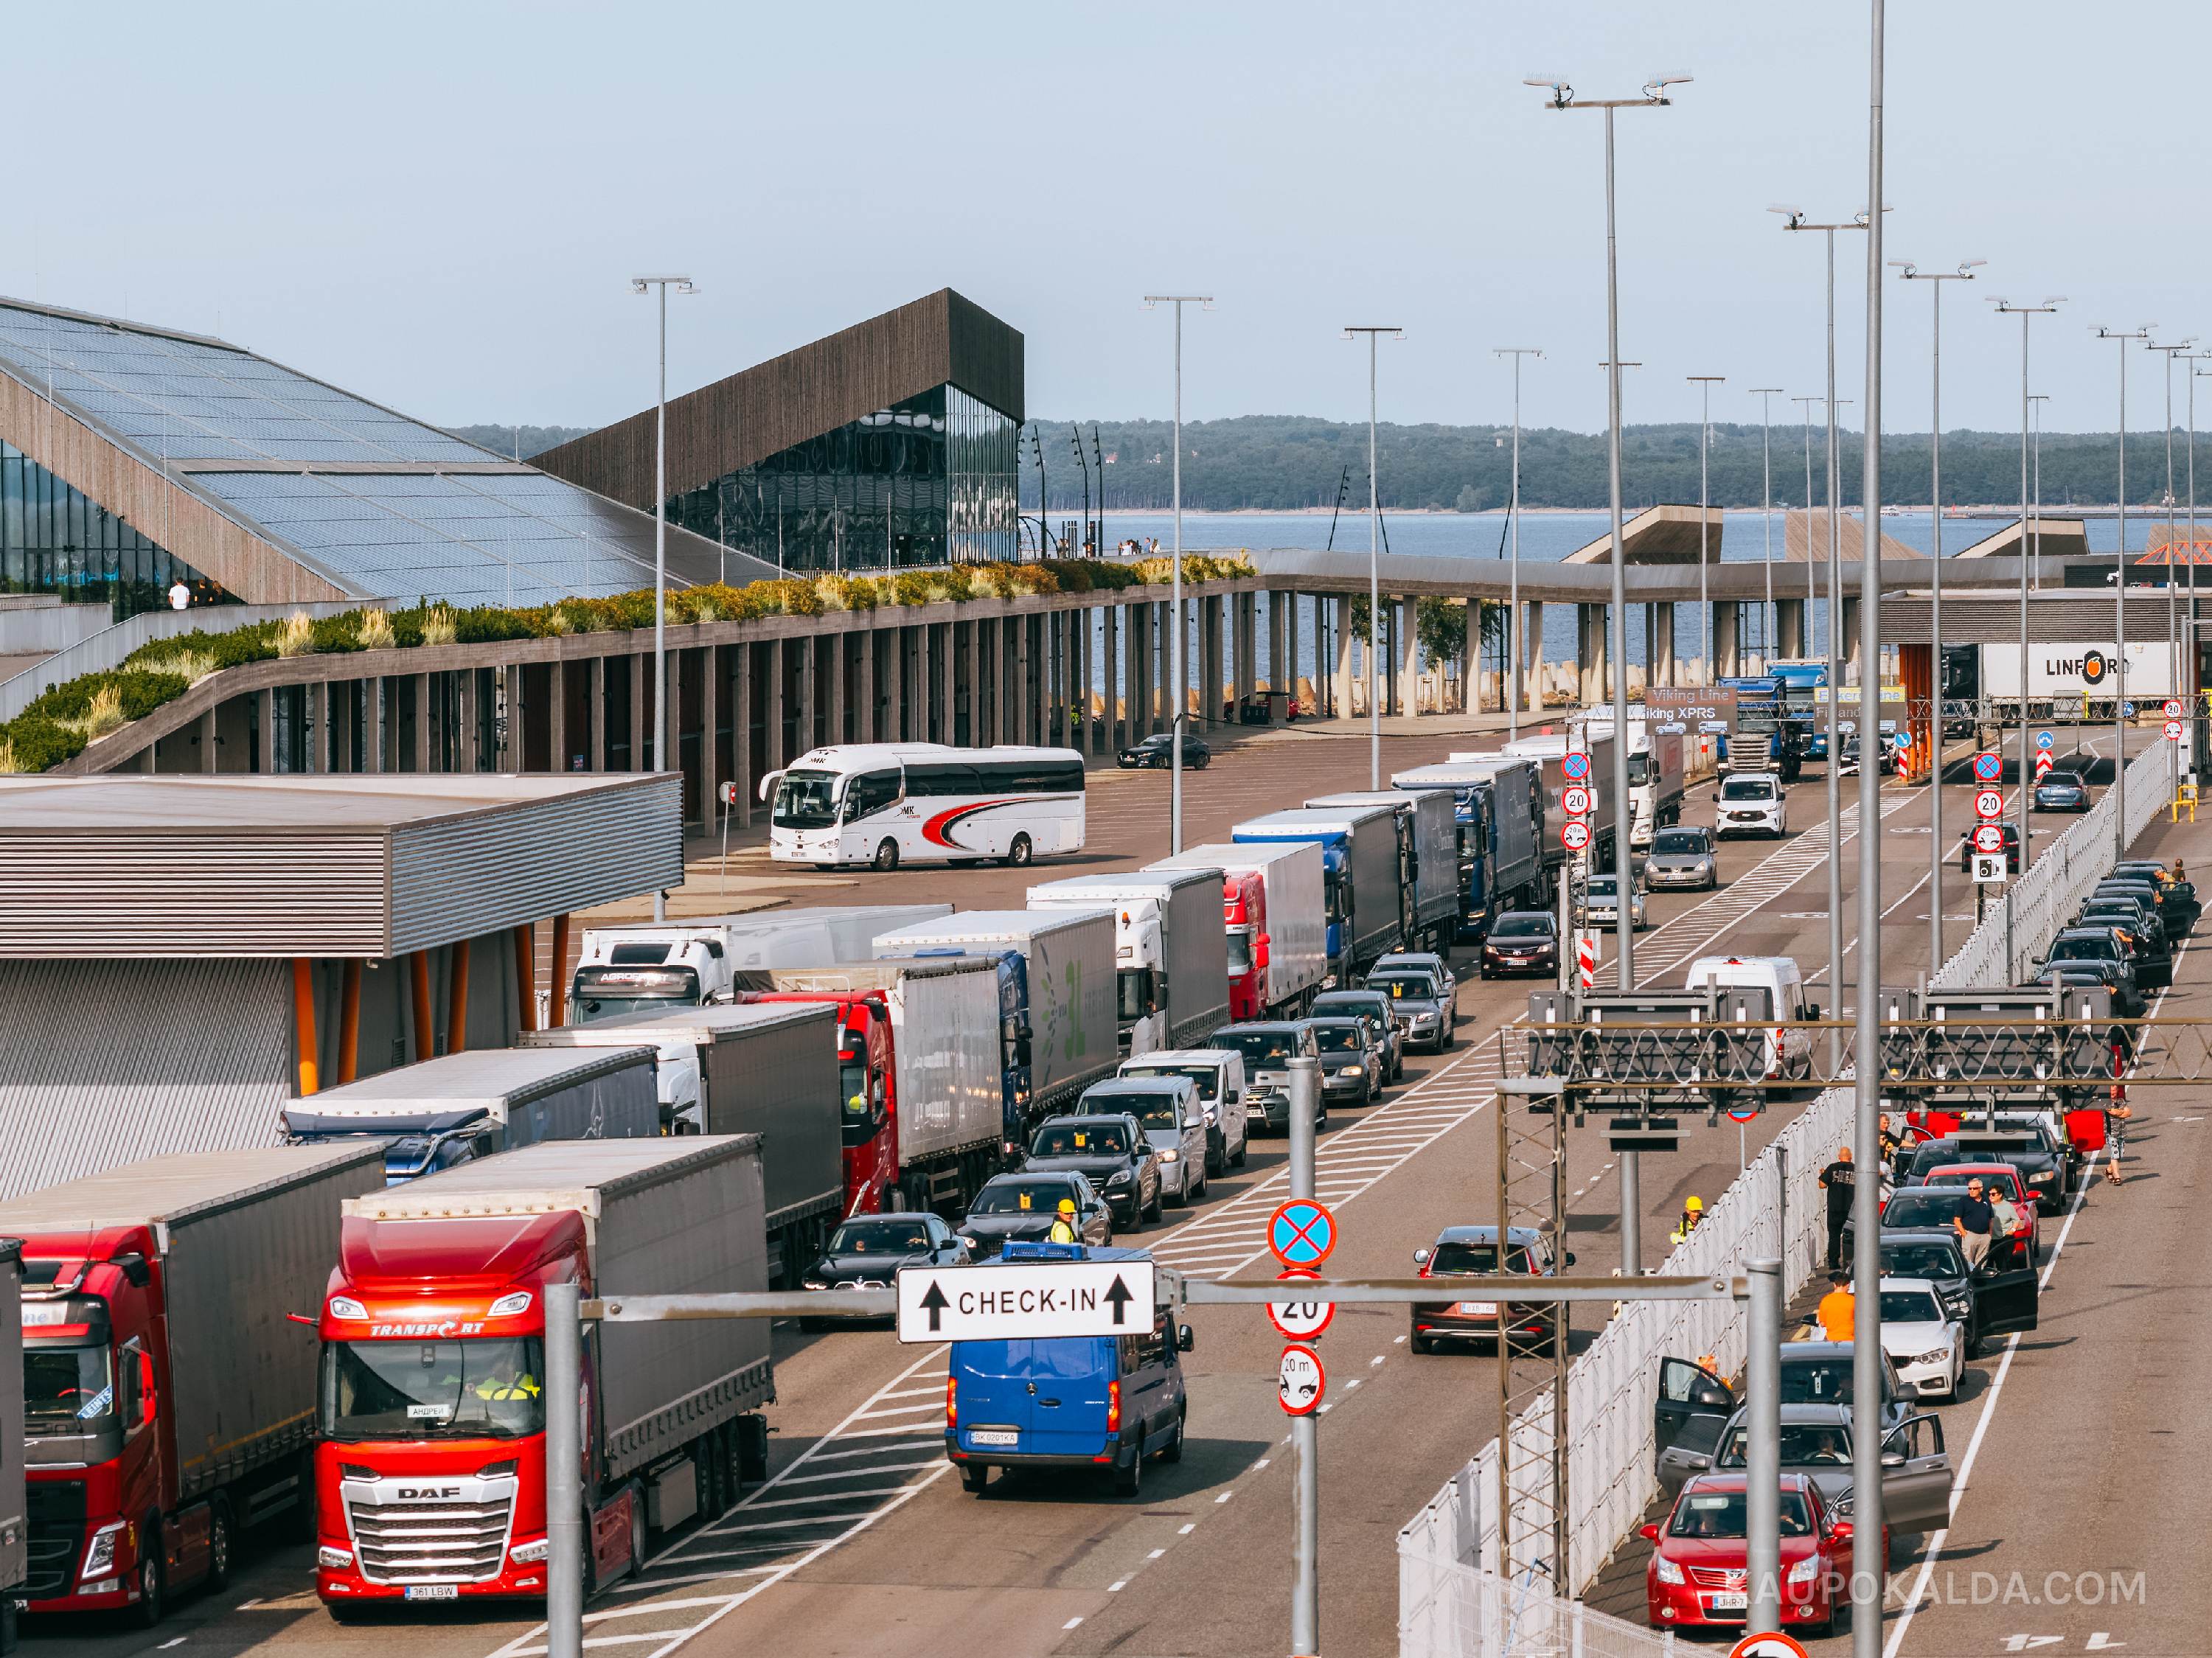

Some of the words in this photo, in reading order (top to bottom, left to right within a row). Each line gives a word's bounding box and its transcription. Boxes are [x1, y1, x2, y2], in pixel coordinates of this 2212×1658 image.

[2047, 649, 2129, 685] LINFOR
[1652, 689, 1695, 703] Viking
[1700, 689, 1729, 701] Line
[1646, 707, 1674, 722] iking
[1678, 707, 1716, 719] XPRS
[1816, 707, 1861, 718] Fiand
[1569, 795, 1584, 807] 20
[1982, 797, 1997, 810] 20
[902, 806, 914, 815] MK
[959, 1288, 1095, 1314] CHECK-IN
[1282, 1302, 1318, 1320] 20
[24, 1313, 48, 1323] ne
[371, 1320, 484, 1337] TRANSPORT
[1284, 1357, 1295, 1372] 20
[1298, 1361, 1310, 1372] m
[398, 1487, 460, 1499] DAF
[413, 1588, 428, 1596] 361
[431, 1586, 453, 1596] LBW
[1719, 1598, 1745, 1607] JHR-7
